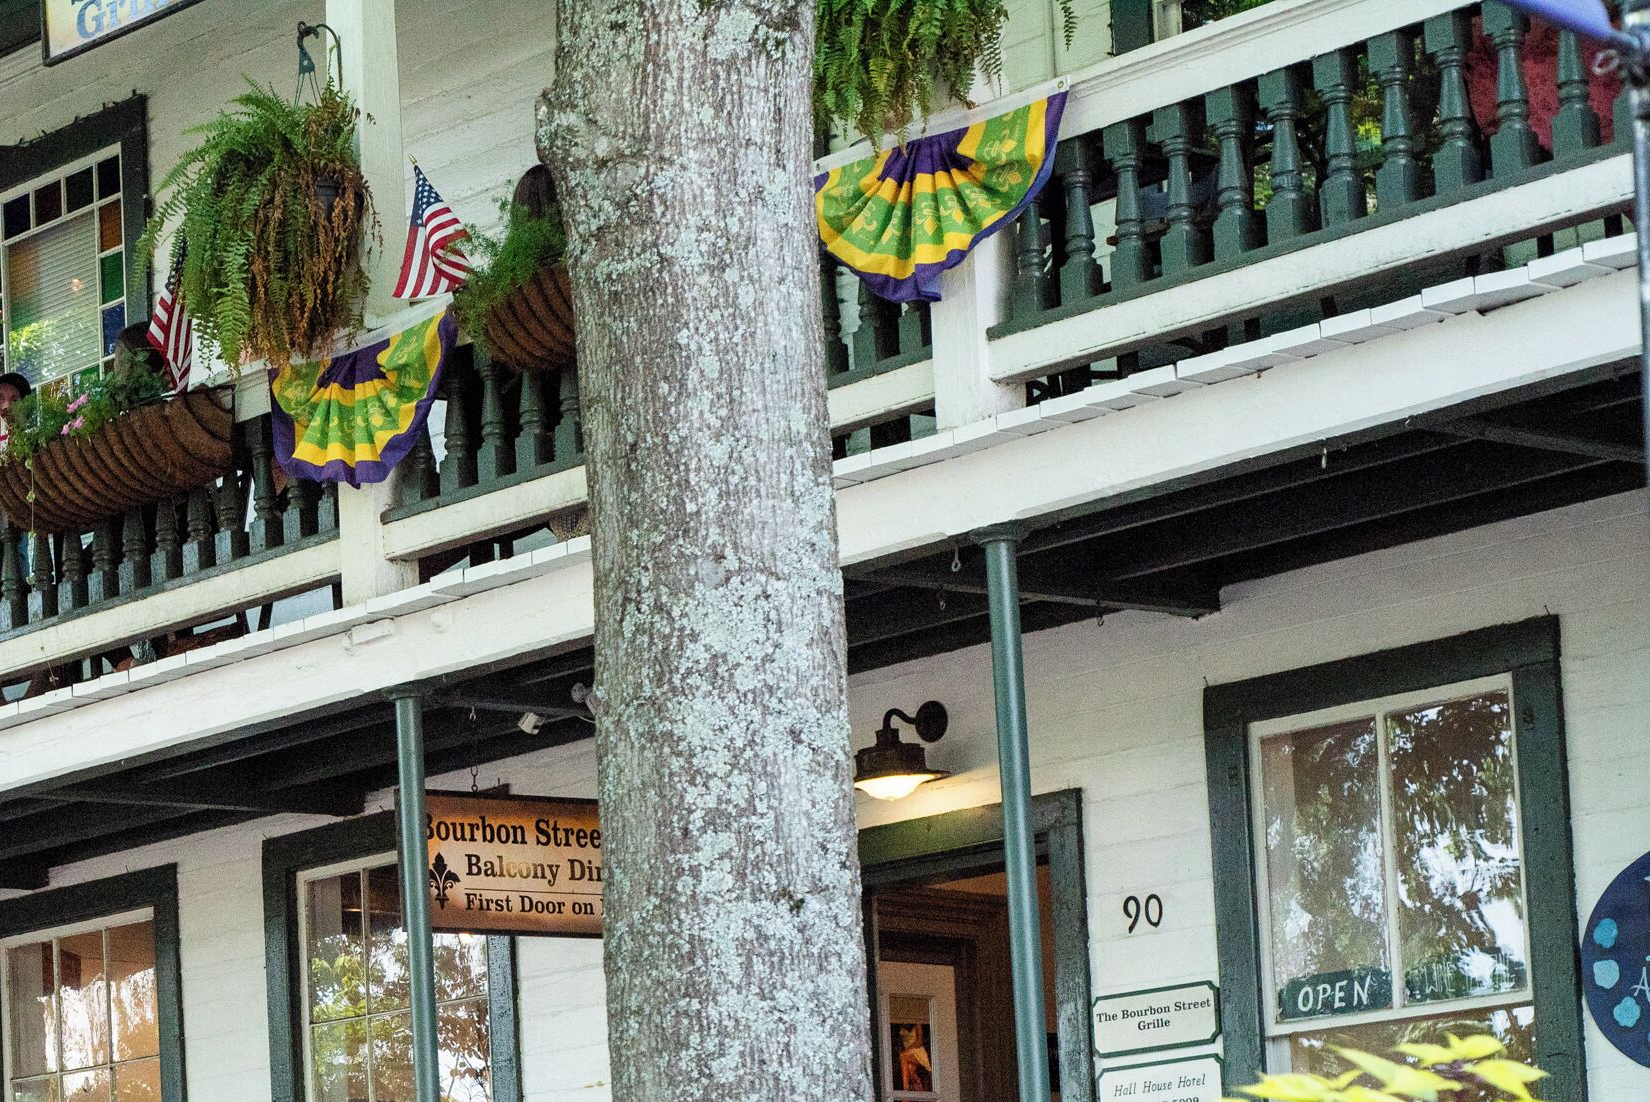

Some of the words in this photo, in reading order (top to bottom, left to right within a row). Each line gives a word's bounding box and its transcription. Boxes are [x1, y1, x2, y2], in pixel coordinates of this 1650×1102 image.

[535, 817, 601, 849] Stree
[465, 853, 560, 887] Balcony
[465, 892, 513, 913] First
[520, 895, 566, 914] Door
[572, 901, 595, 916] on
[1122, 893, 1163, 934] 90
[1297, 971, 1371, 1012] OPEN
[1096, 1010, 1118, 1023] The
[1121, 1004, 1171, 1020] Bourbon
[1174, 997, 1211, 1012] Street
[1137, 1017, 1171, 1031] Grille
[1114, 1082, 1137, 1097] Hall
[1142, 1079, 1173, 1093] House
[1178, 1073, 1206, 1089] Hotel
